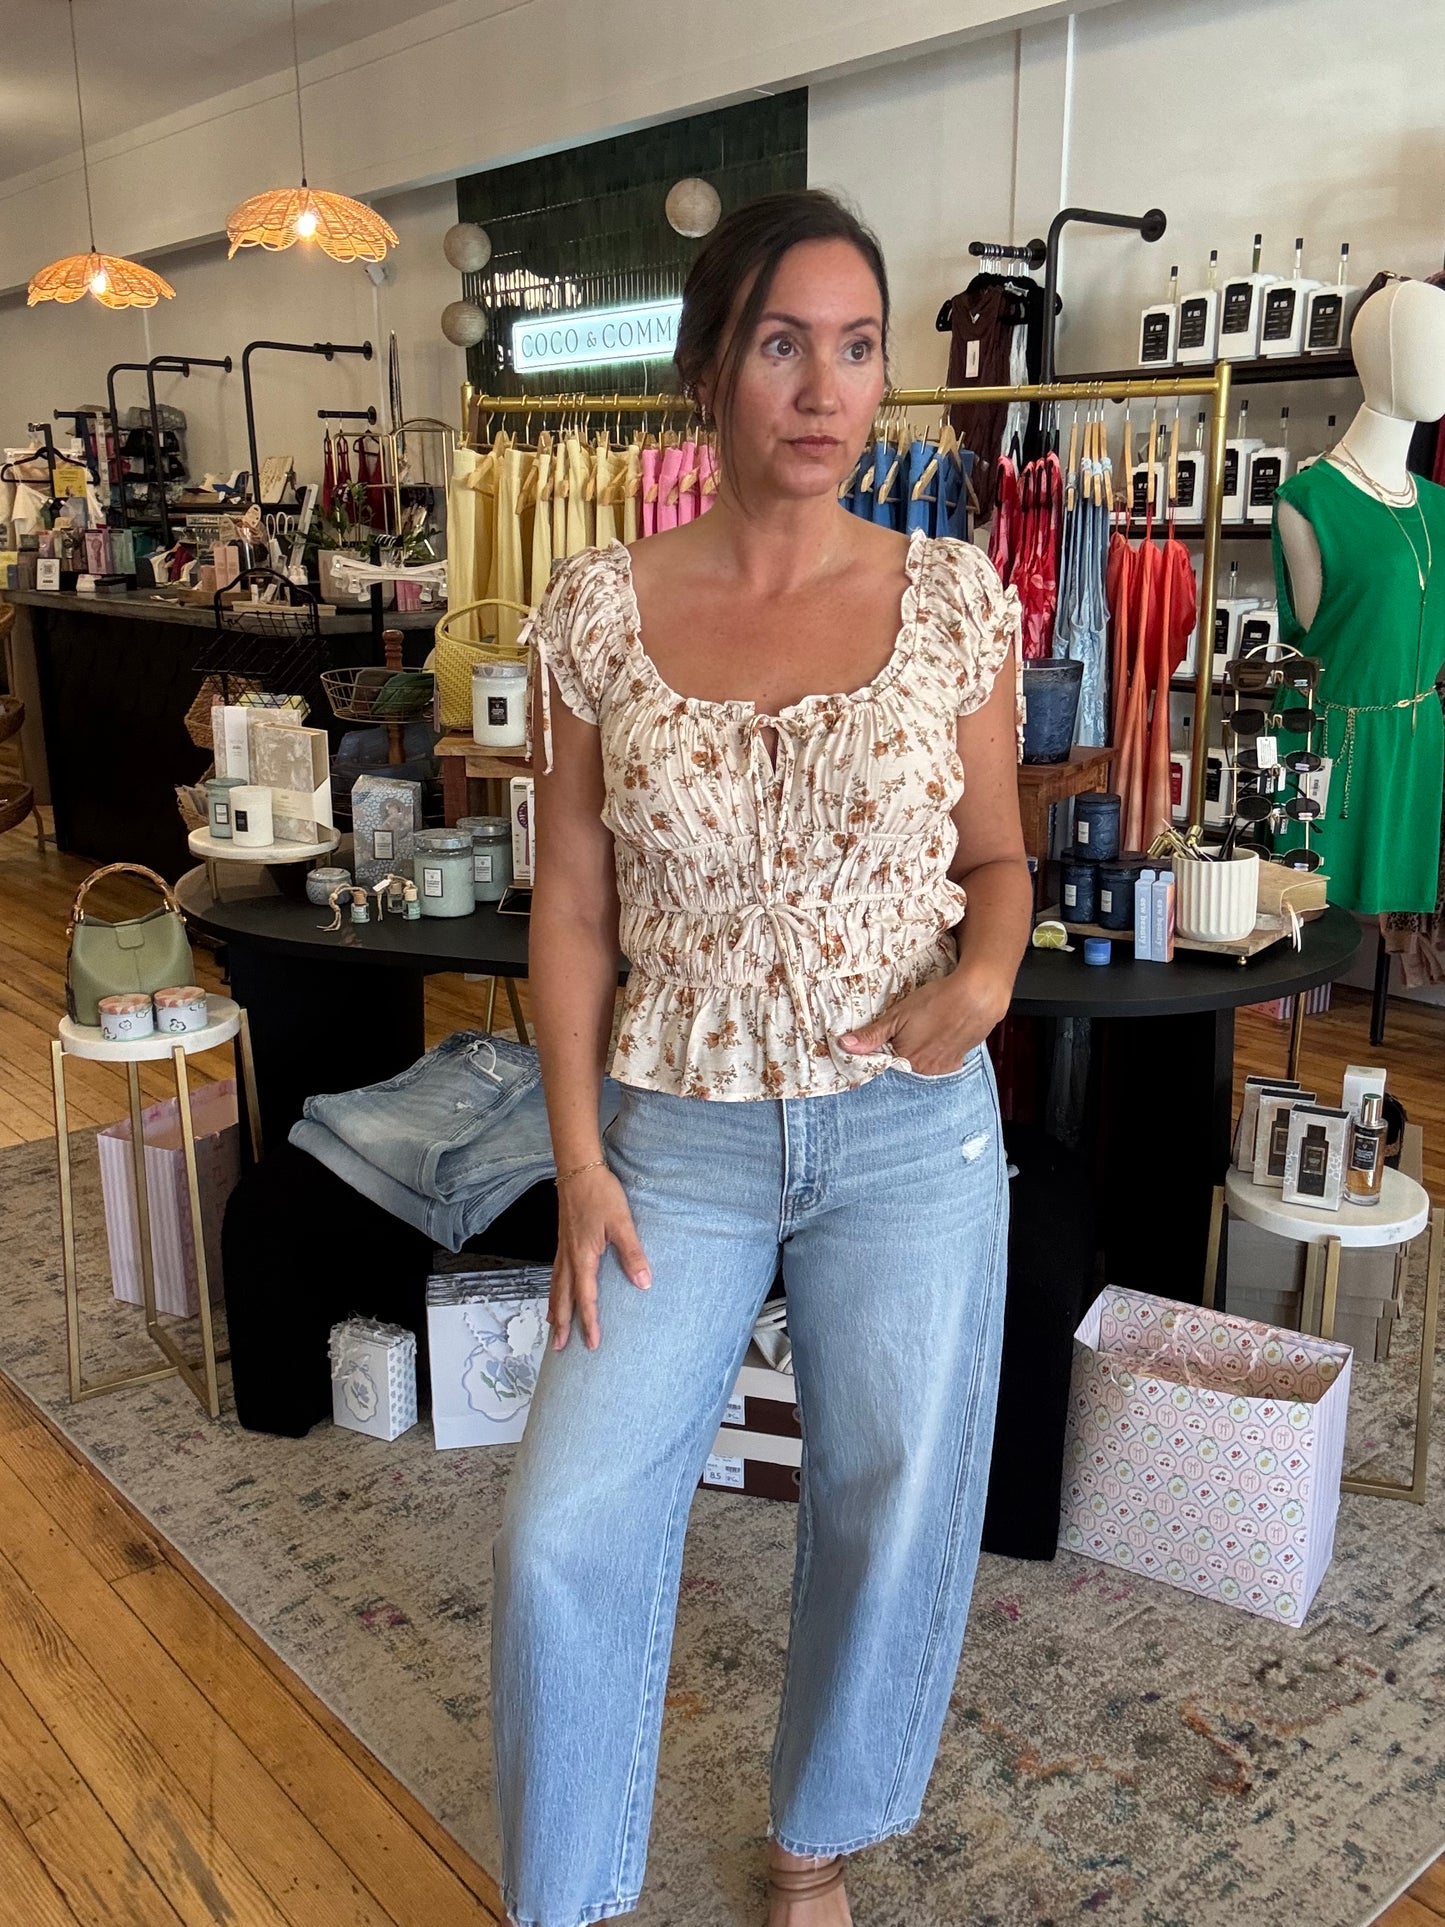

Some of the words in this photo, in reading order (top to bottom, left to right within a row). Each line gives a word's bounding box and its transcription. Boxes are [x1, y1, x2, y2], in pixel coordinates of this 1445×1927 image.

[521, 328, 579, 359] COCO
[586, 331, 597, 349] &
[602, 316, 673, 349] COMM
